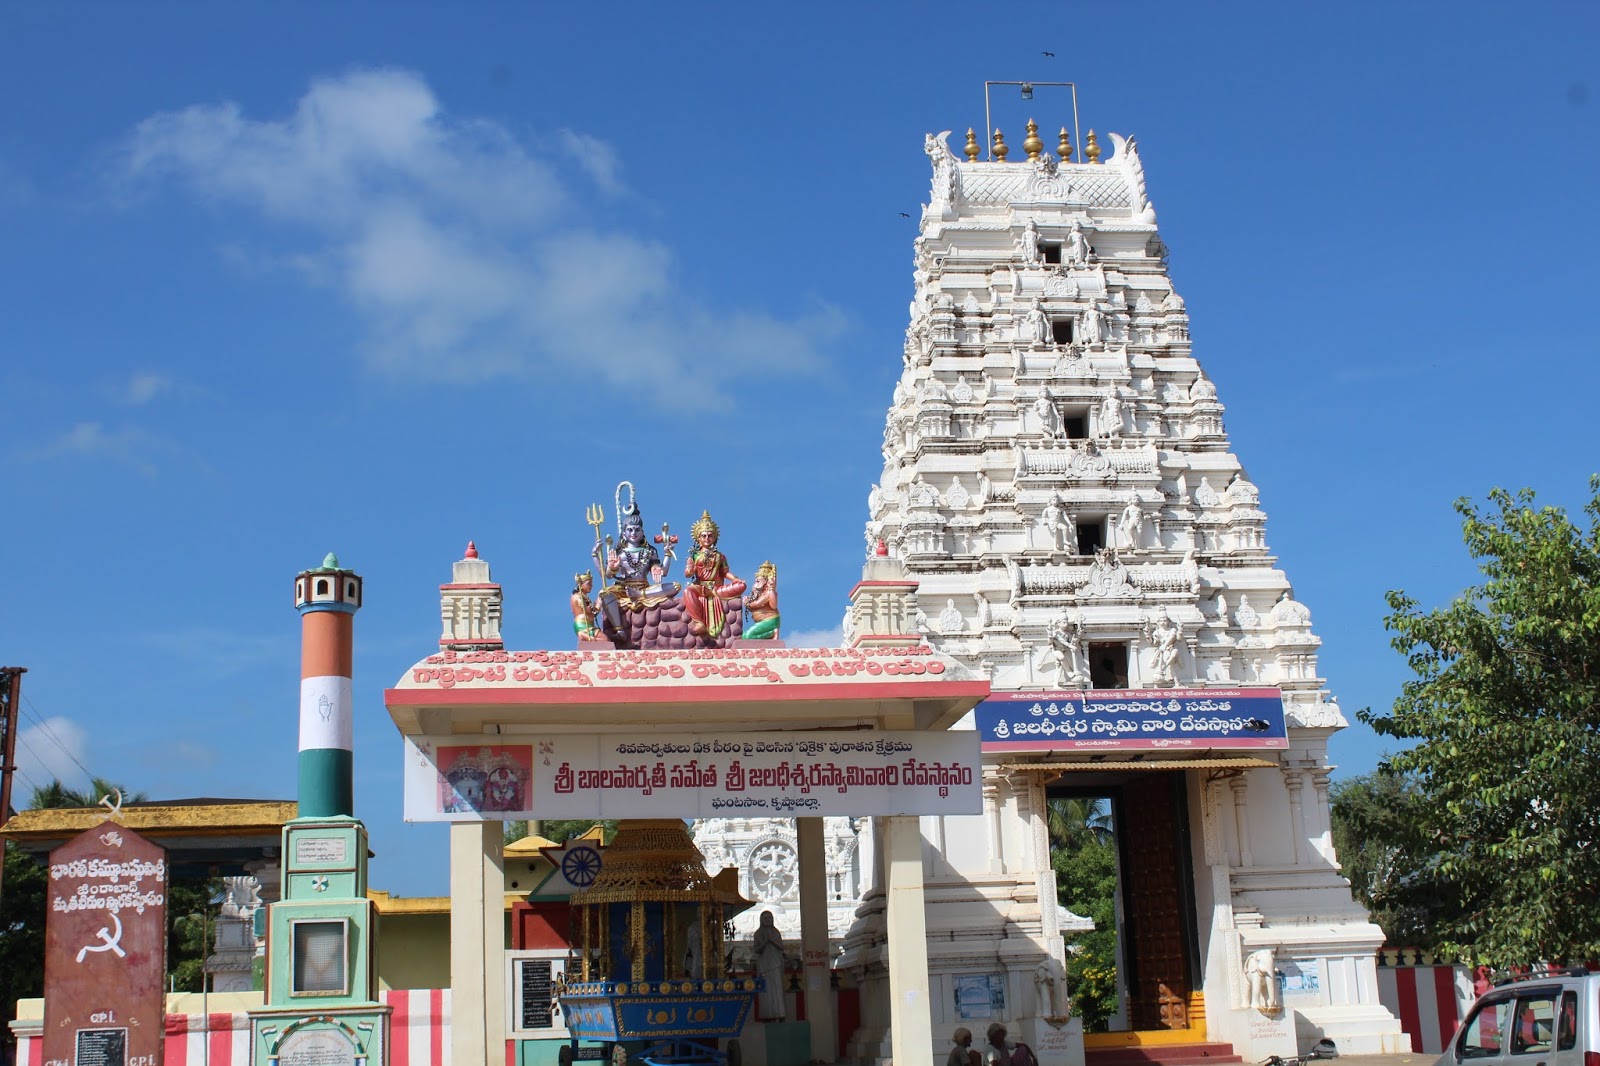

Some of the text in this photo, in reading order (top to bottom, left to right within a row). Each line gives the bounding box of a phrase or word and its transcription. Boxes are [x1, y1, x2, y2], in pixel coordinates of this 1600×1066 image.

[1028, 702, 1044, 716] శ్రీ
[1045, 702, 1060, 716] శ్రీ
[1061, 702, 1077, 716] శ్రీ
[1186, 700, 1232, 712] సమేత
[993, 719, 1011, 739] శ్రీ
[1092, 718, 1139, 737] స్వామి
[1141, 717, 1177, 733] వారి
[1180, 715, 1270, 735] దేవస్థాన
[616, 742, 691, 757] శివపార్వతులు
[755, 741, 794, 753] వెలసిన
[829, 740, 874, 754] పురాతన
[875, 740, 912, 756] క్షేత్రము
[554, 762, 575, 794] శ్రీ
[578, 762, 667, 796] బాలపార్వతీ
[670, 759, 718, 789] సమేత
[725, 760, 746, 792] శ్రీ
[902, 758, 973, 799] దేవస్థానం
